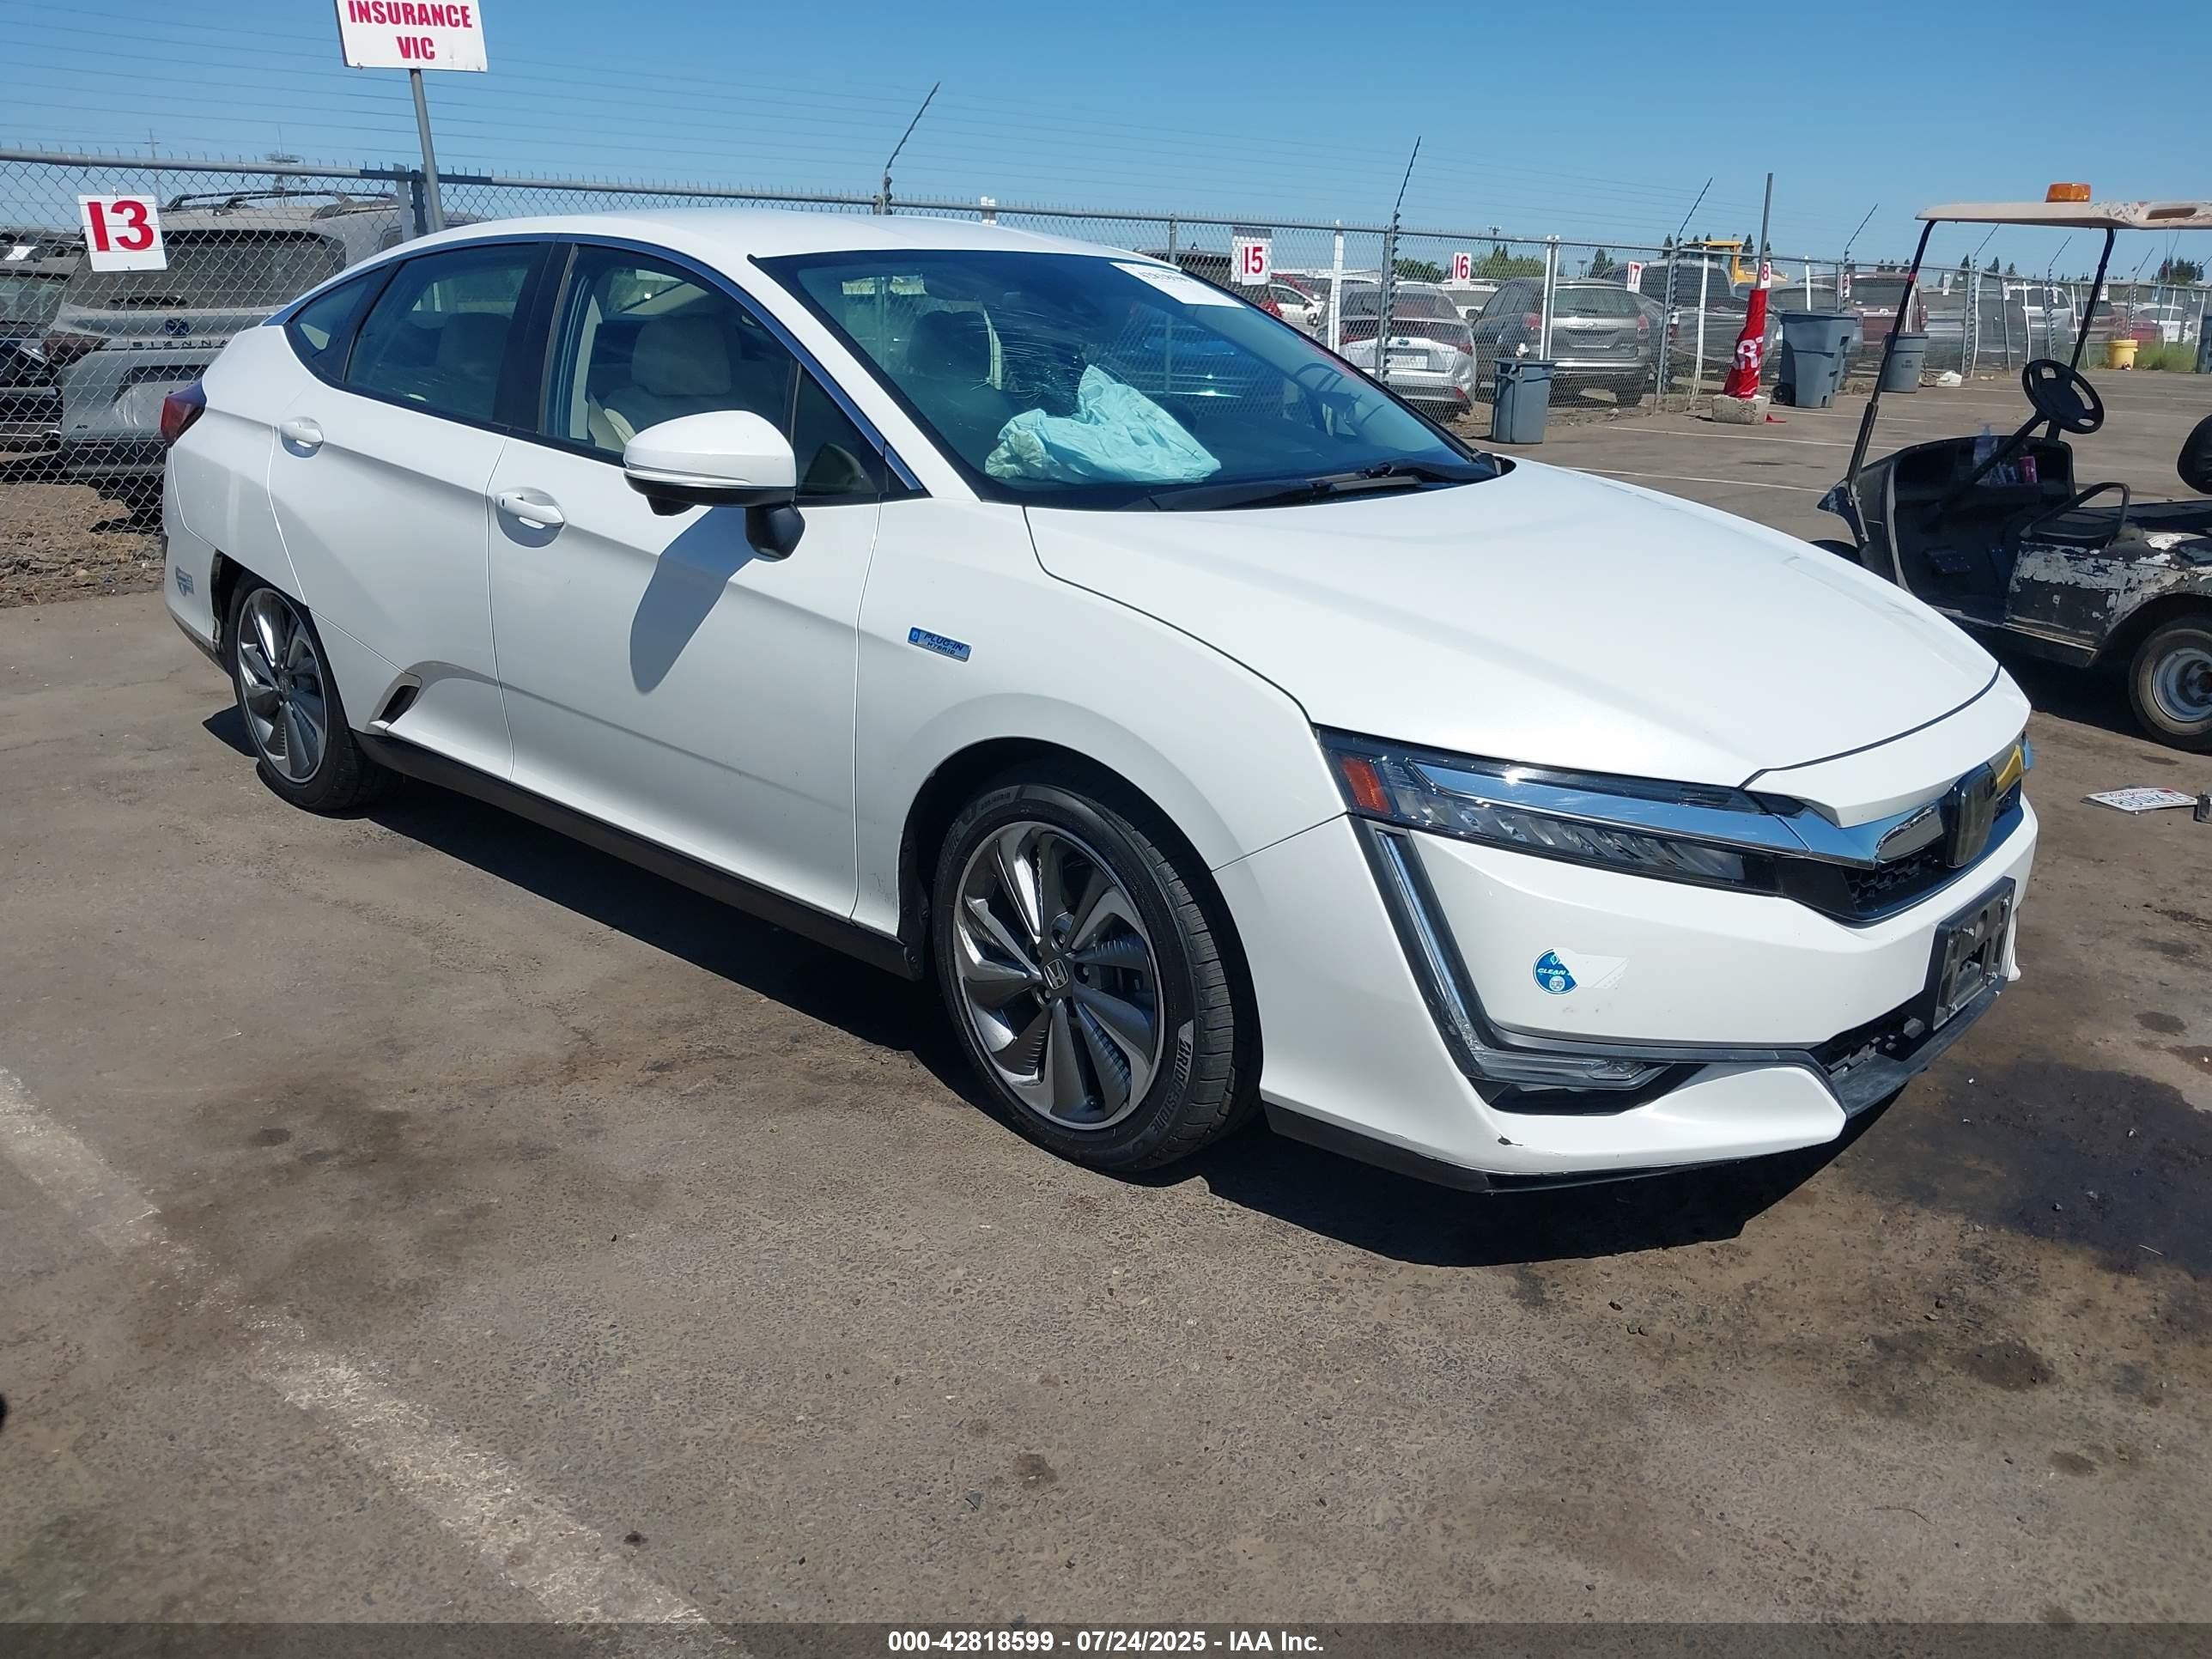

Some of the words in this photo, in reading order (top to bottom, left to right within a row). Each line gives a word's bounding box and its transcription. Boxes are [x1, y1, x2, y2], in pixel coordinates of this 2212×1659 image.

[348, 0, 472, 28] INSURANCE
[397, 36, 435, 60] VIC
[87, 200, 154, 252] 13
[1244, 246, 1263, 274] 15
[1455, 255, 1468, 279] 16
[1629, 264, 1640, 284] 17
[924, 632, 963, 651] PLUG-IN
[927, 641, 955, 654] HYBRID
